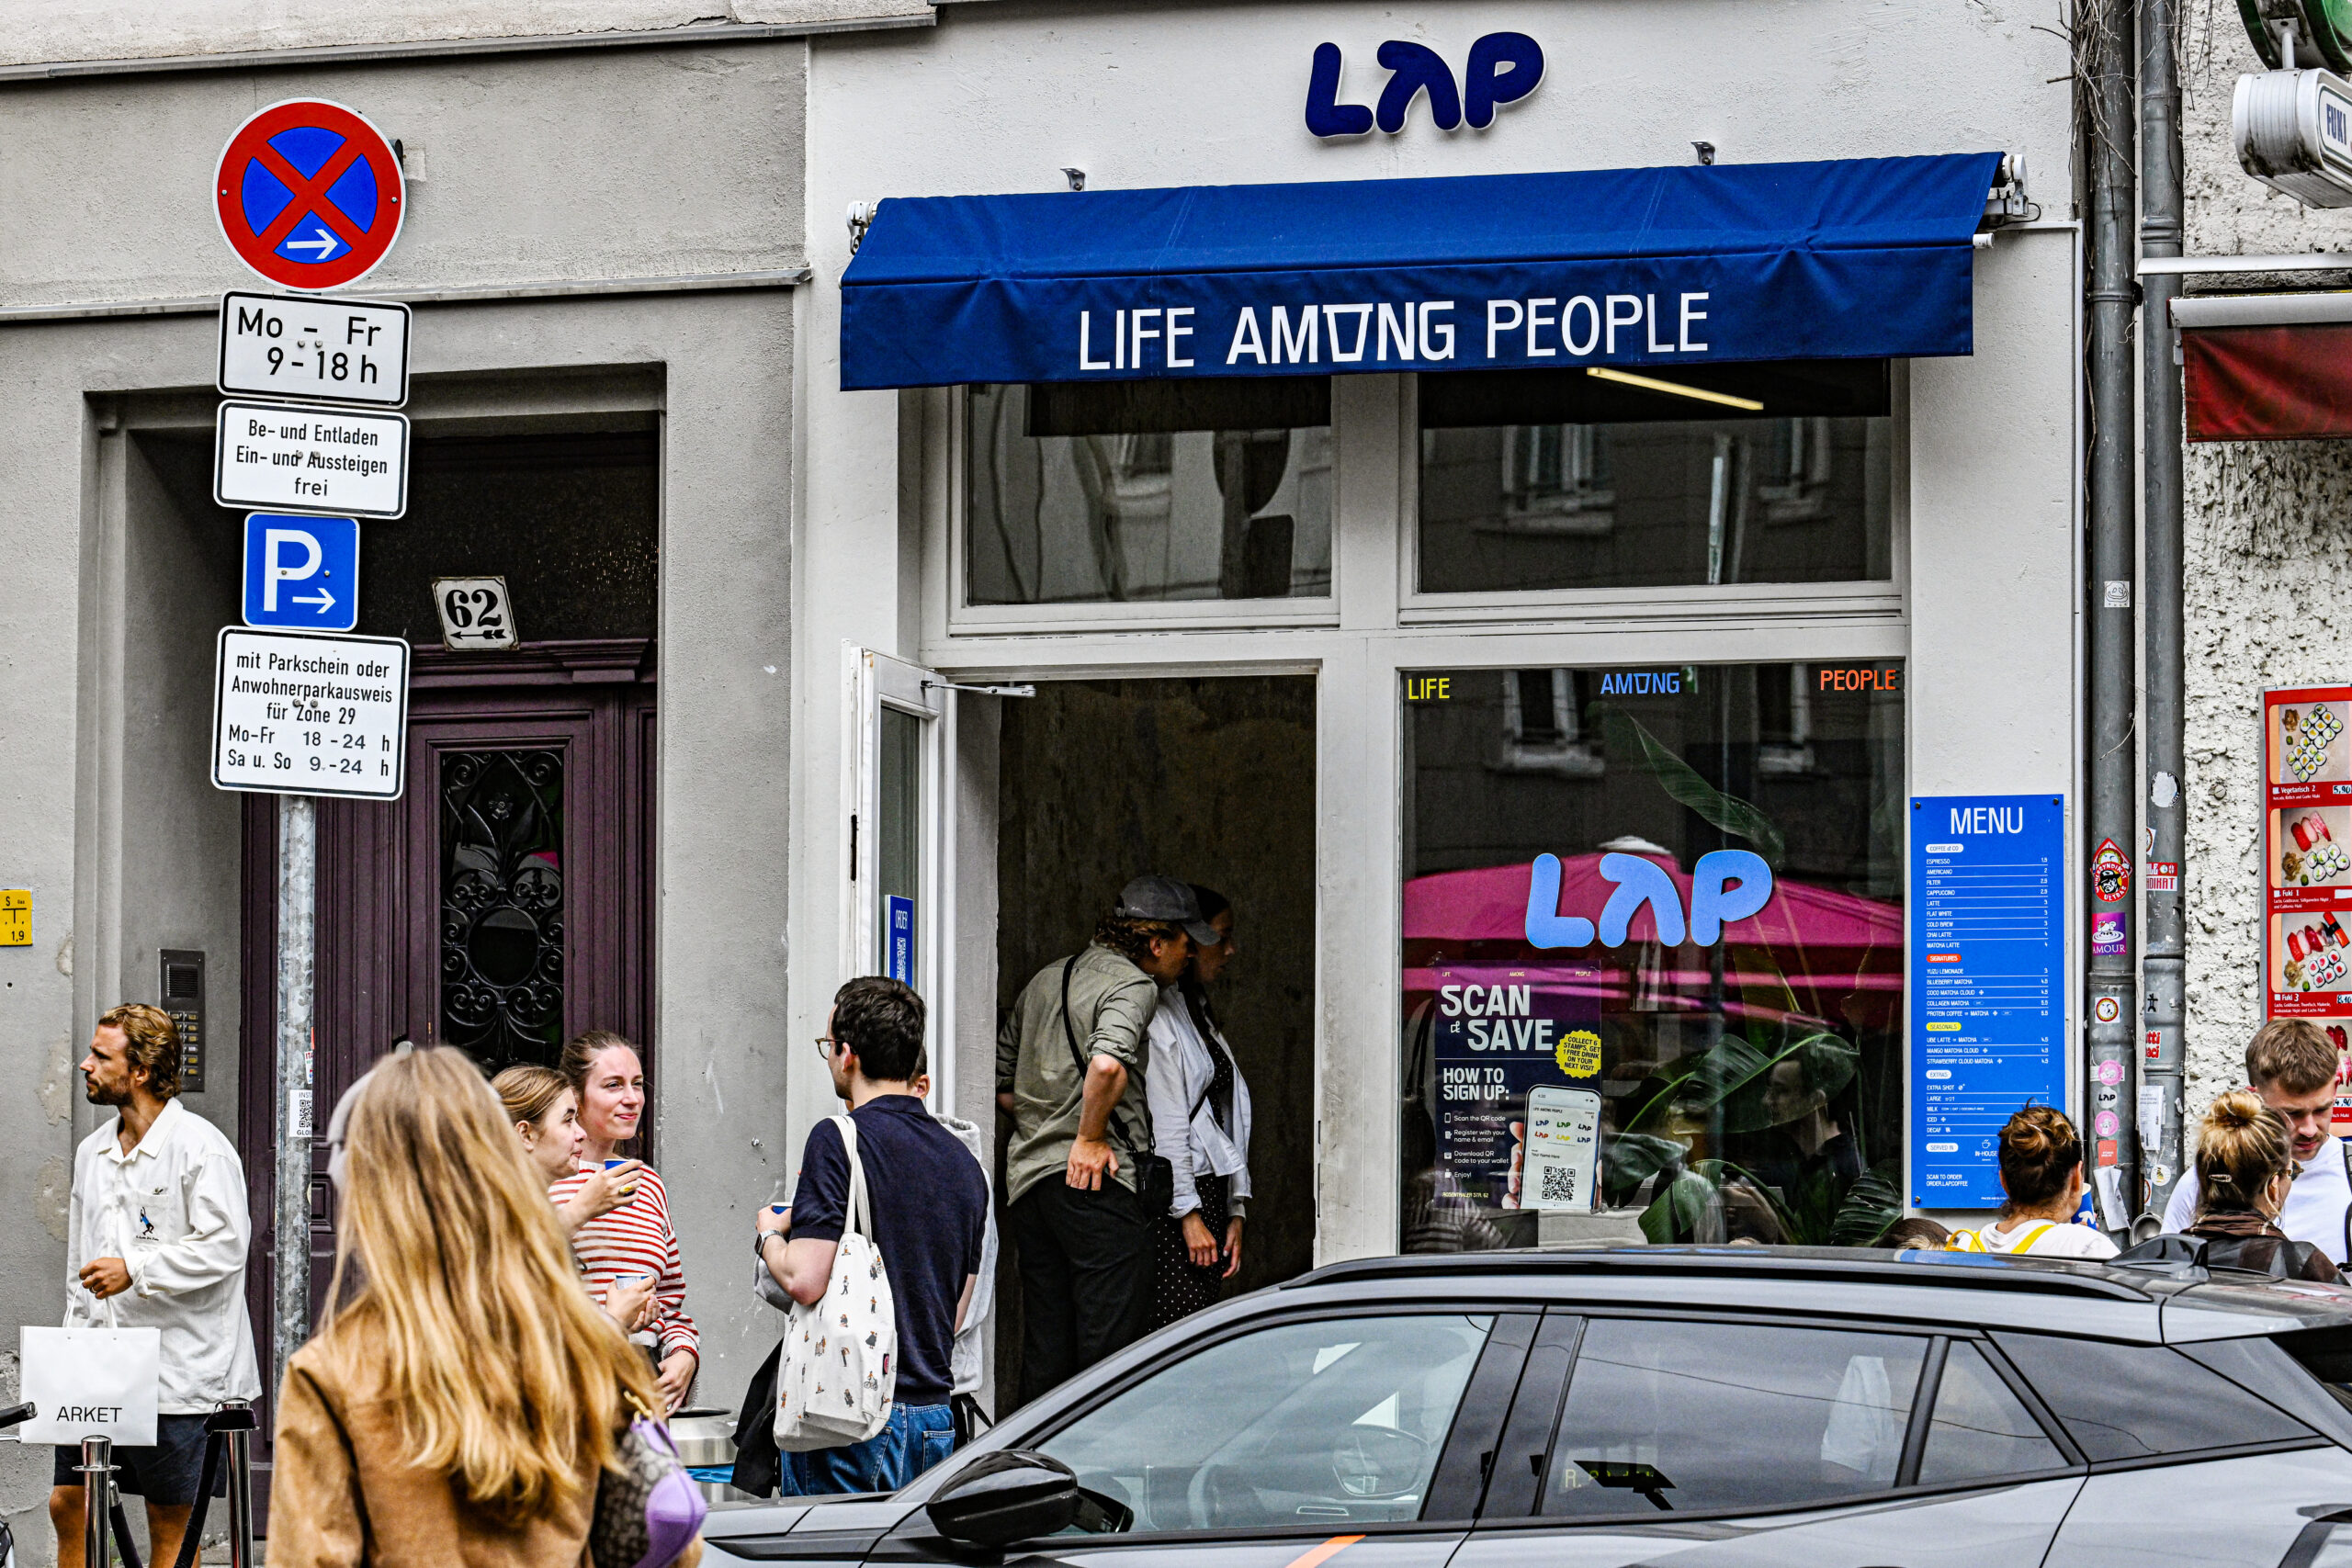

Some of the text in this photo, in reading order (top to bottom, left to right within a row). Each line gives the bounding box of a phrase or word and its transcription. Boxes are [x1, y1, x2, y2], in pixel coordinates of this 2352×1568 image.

[2326, 103, 2347, 145] FUKI
[238, 306, 283, 338] Mo
[347, 316, 382, 346] Fr
[1080, 306, 1196, 372] LIFE
[1487, 291, 1710, 359] PEOPLE
[280, 423, 307, 440] und
[314, 425, 378, 446] Entladen
[272, 450, 299, 467] und
[307, 451, 388, 477] Aussteigen
[295, 477, 328, 496] frei
[263, 528, 322, 612] P
[445, 589, 502, 627] 62
[236, 652, 390, 678] mit Parkschein oder
[231, 675, 392, 703] Anwohnerparkausweis
[1407, 677, 1451, 700] LIFE
[1820, 669, 1897, 691] PEOPLE
[266, 703, 356, 725] für Zone 29
[228, 724, 275, 744] Mo-Fr
[382, 735, 390, 751] h
[227, 749, 245, 766] Sa
[253, 754, 266, 768] u.
[274, 752, 291, 770] So
[381, 759, 389, 776] h
[2281, 786, 2310, 795] Vegetarisch
[1950, 807, 2024, 835] MENU
[2104, 886, 2127, 901] ULTRAS
[895, 909, 908, 930] ORDER
[12, 931, 24, 942] 1,9
[1441, 984, 1530, 1016] SCAN
[2294, 994, 2299, 1002] 3
[1468, 1019, 1553, 1051] SAVE
[1563, 1043, 1588, 1051] STAMPS,
[1568, 1036, 1592, 1045] COLLECT
[1443, 1068, 1504, 1084] HOW TO
[1443, 1085, 1510, 1100] SIGN UP:
[56, 1406, 122, 1423] ARKET
